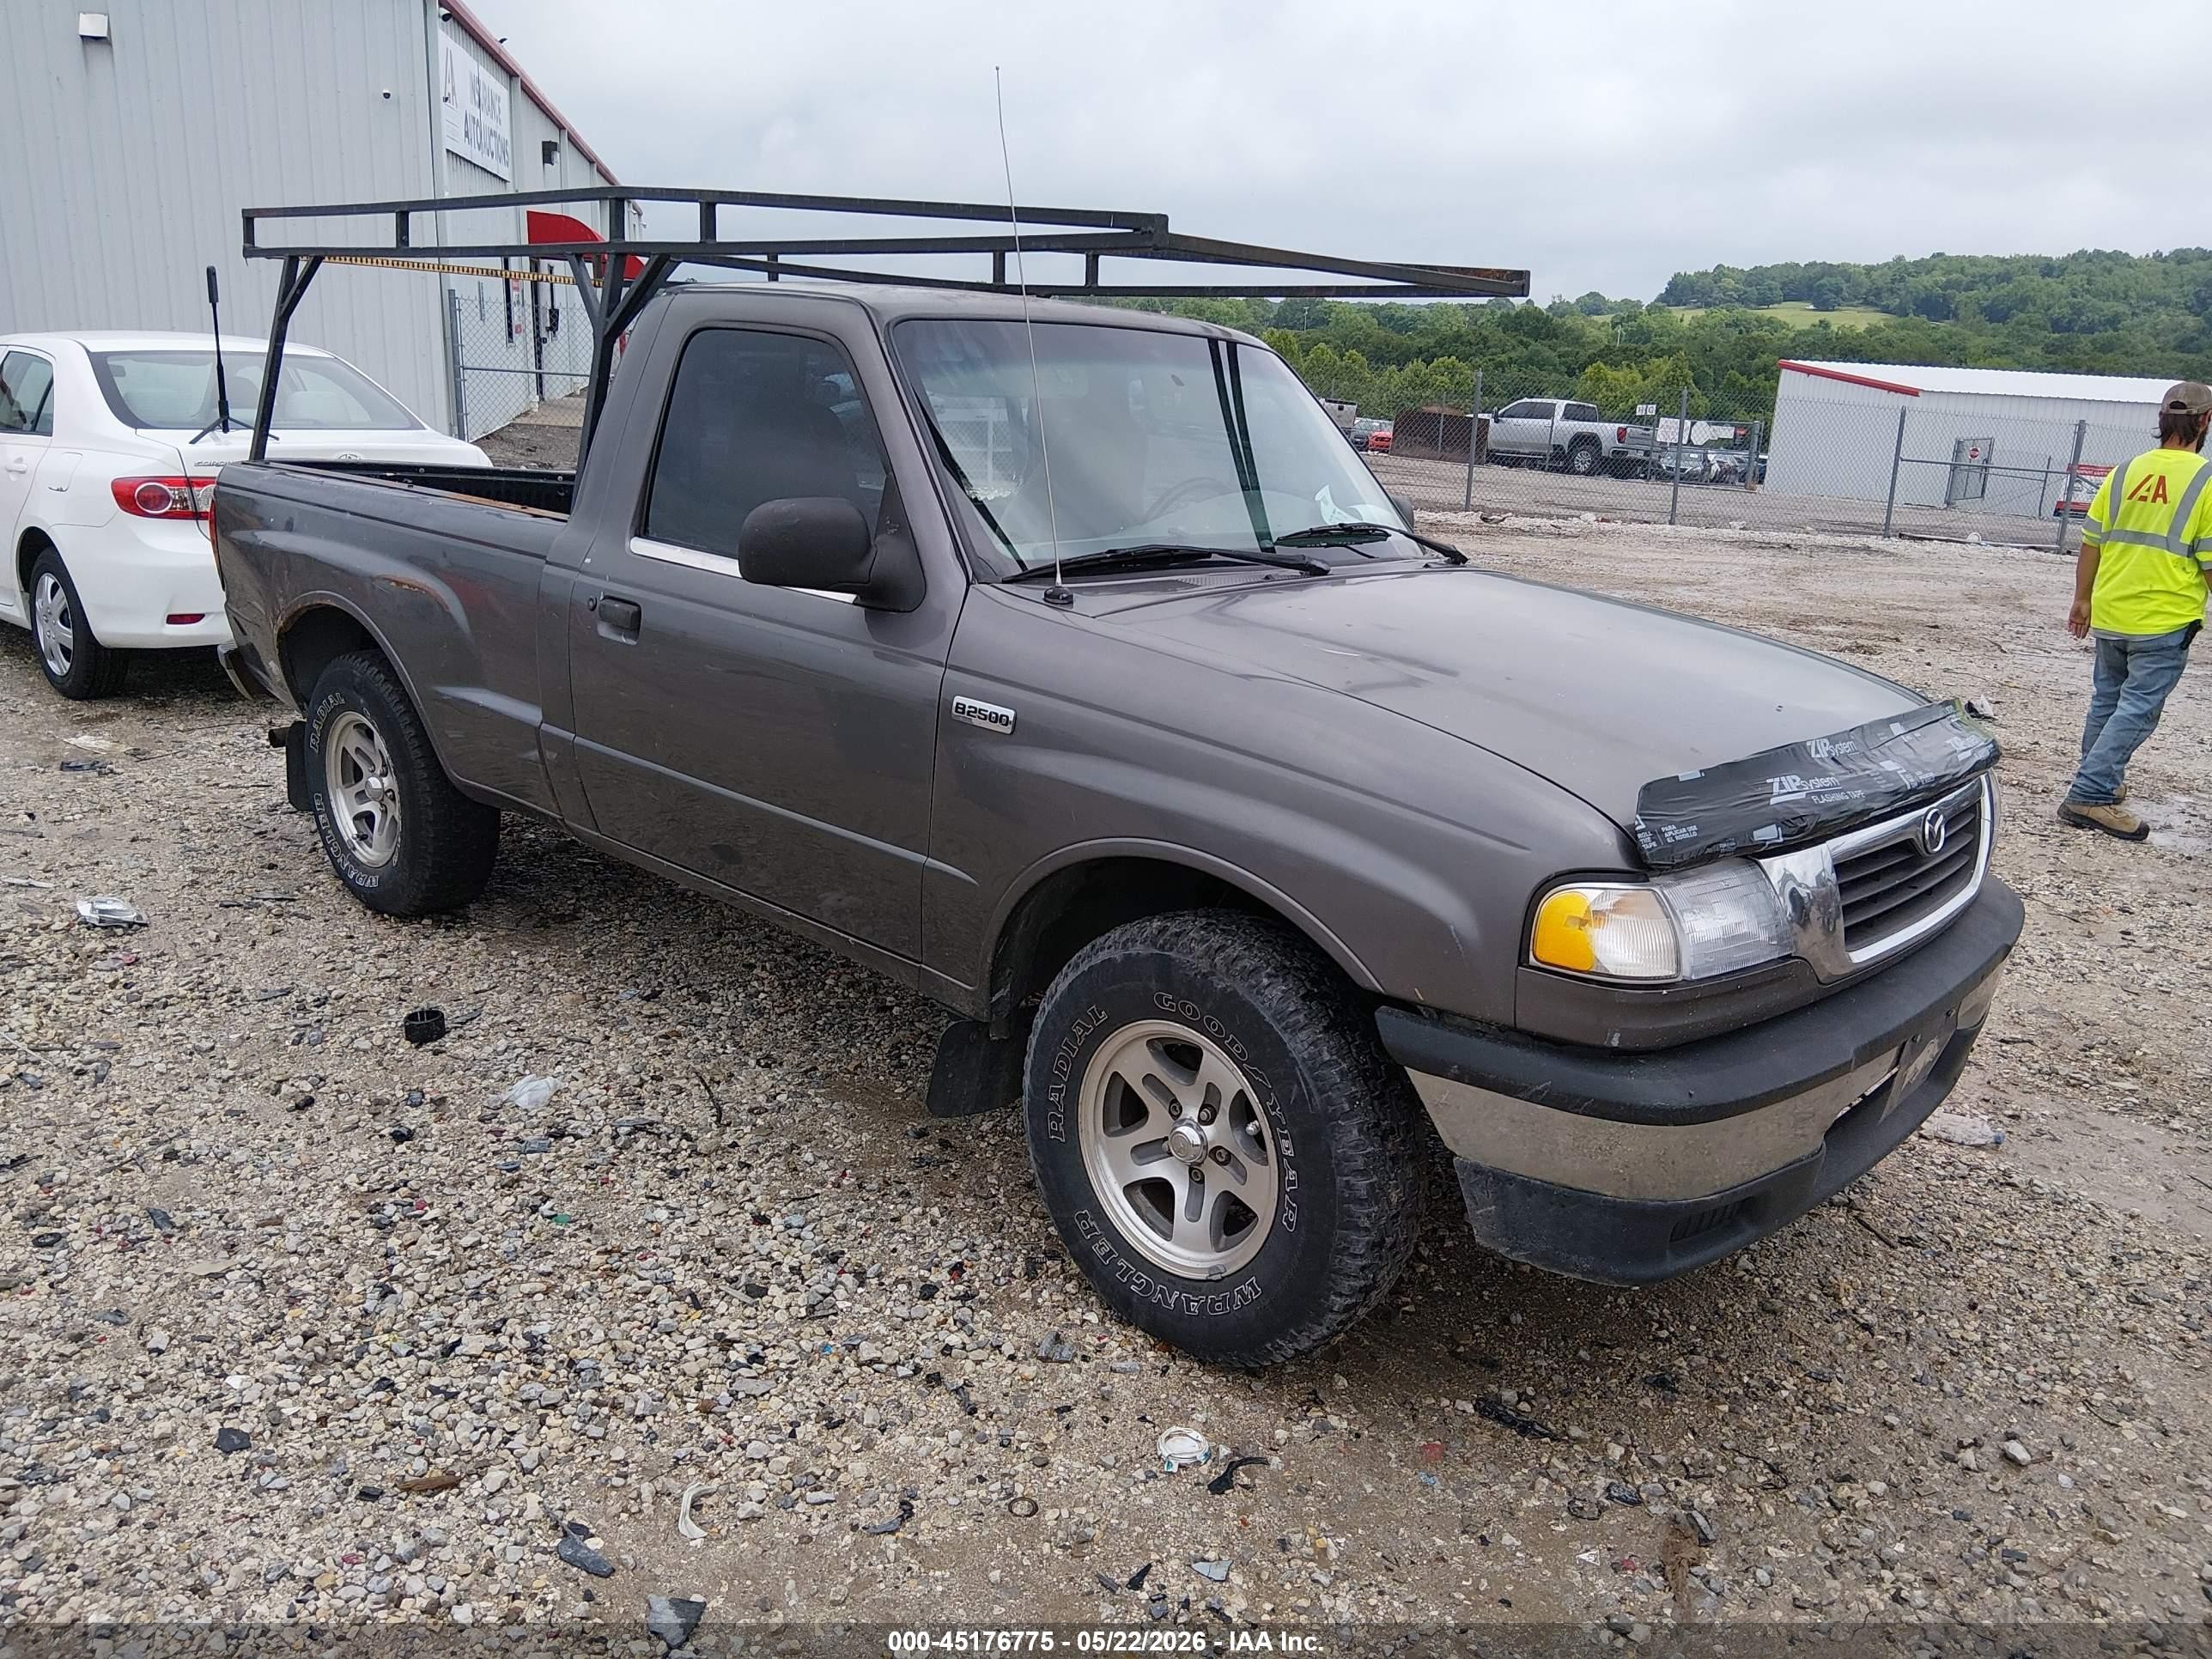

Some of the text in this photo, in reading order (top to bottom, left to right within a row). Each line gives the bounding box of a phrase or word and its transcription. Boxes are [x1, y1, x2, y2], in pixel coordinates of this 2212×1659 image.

[310, 692, 345, 754] RADIAL
[954, 702, 1010, 726] B2500
[1811, 789, 1866, 805] FLASHING TAPE
[313, 793, 380, 888] WRANGLER
[1047, 1004, 1108, 1143] RADIAL
[1073, 1209, 1262, 1316] WRANGLER
